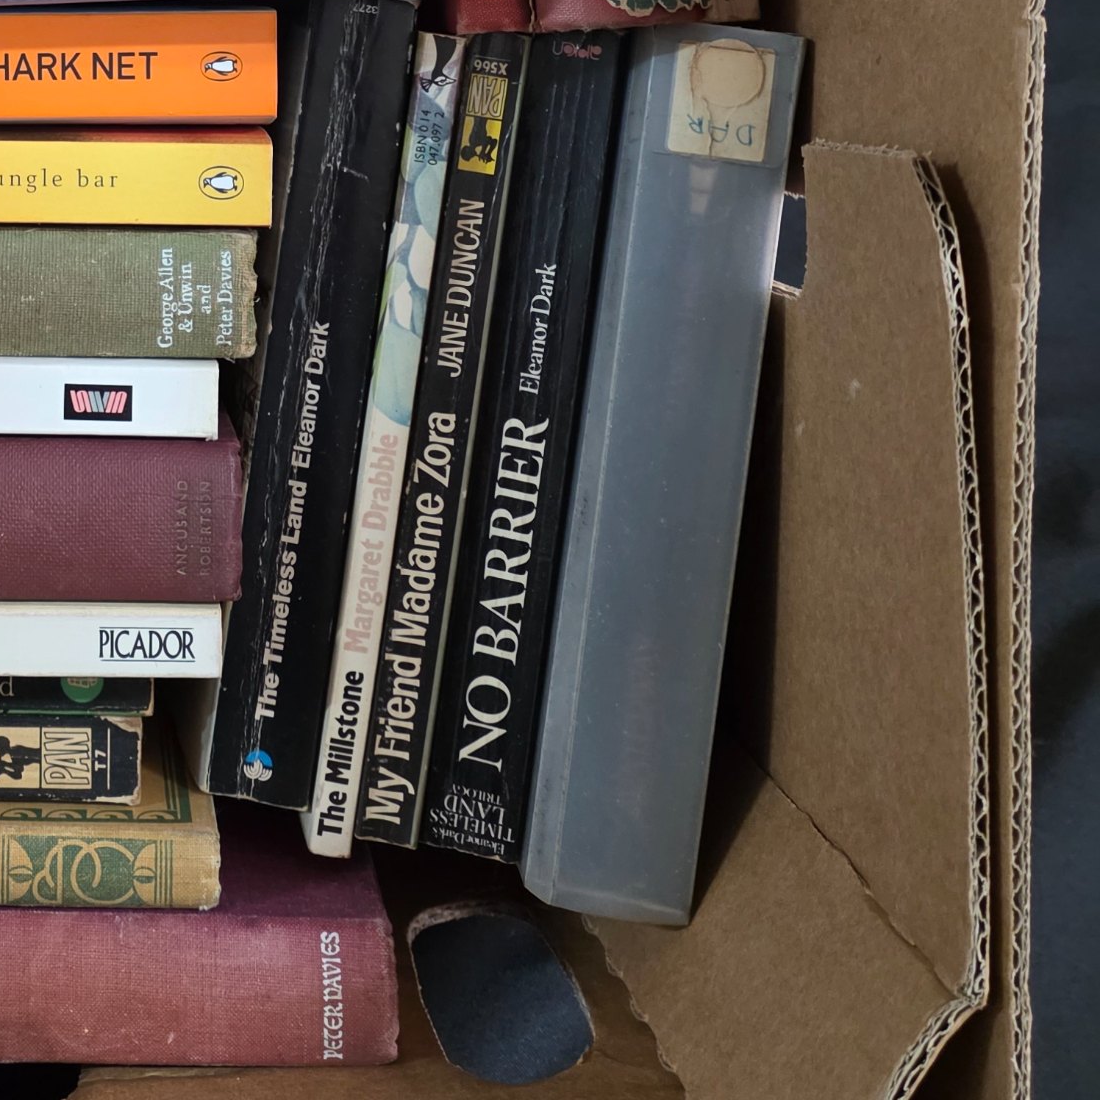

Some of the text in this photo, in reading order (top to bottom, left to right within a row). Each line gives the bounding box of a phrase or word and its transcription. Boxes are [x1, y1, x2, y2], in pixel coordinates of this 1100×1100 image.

[92, 51, 158, 80] NET
[474, 60, 508, 75] X566
[466, 74, 506, 117] PAN
[414, 134, 427, 163] ISBN
[76, 168, 119, 189] bar
[157, 247, 178, 348] George Allen
[178, 262, 193, 333] & Unwin
[196, 285, 212, 314] and
[216, 250, 233, 346] Peter Davies
[255, 320, 330, 720] The Timeless Land Eleanor Dark
[365, 199, 486, 824] My Friend Madame Zora JANE DUNCAN
[459, 263, 557, 773] NO BARRIER Eleanor Dark
[99, 629, 195, 661] PICADOR
[317, 433, 399, 836] The Millstone Margaret Drabble
[44, 732, 90, 785] PAN
[429, 808, 515, 842] TIMELESS
[444, 794, 505, 824] LAND
[321, 931, 343, 1060] PETER DAVIES
